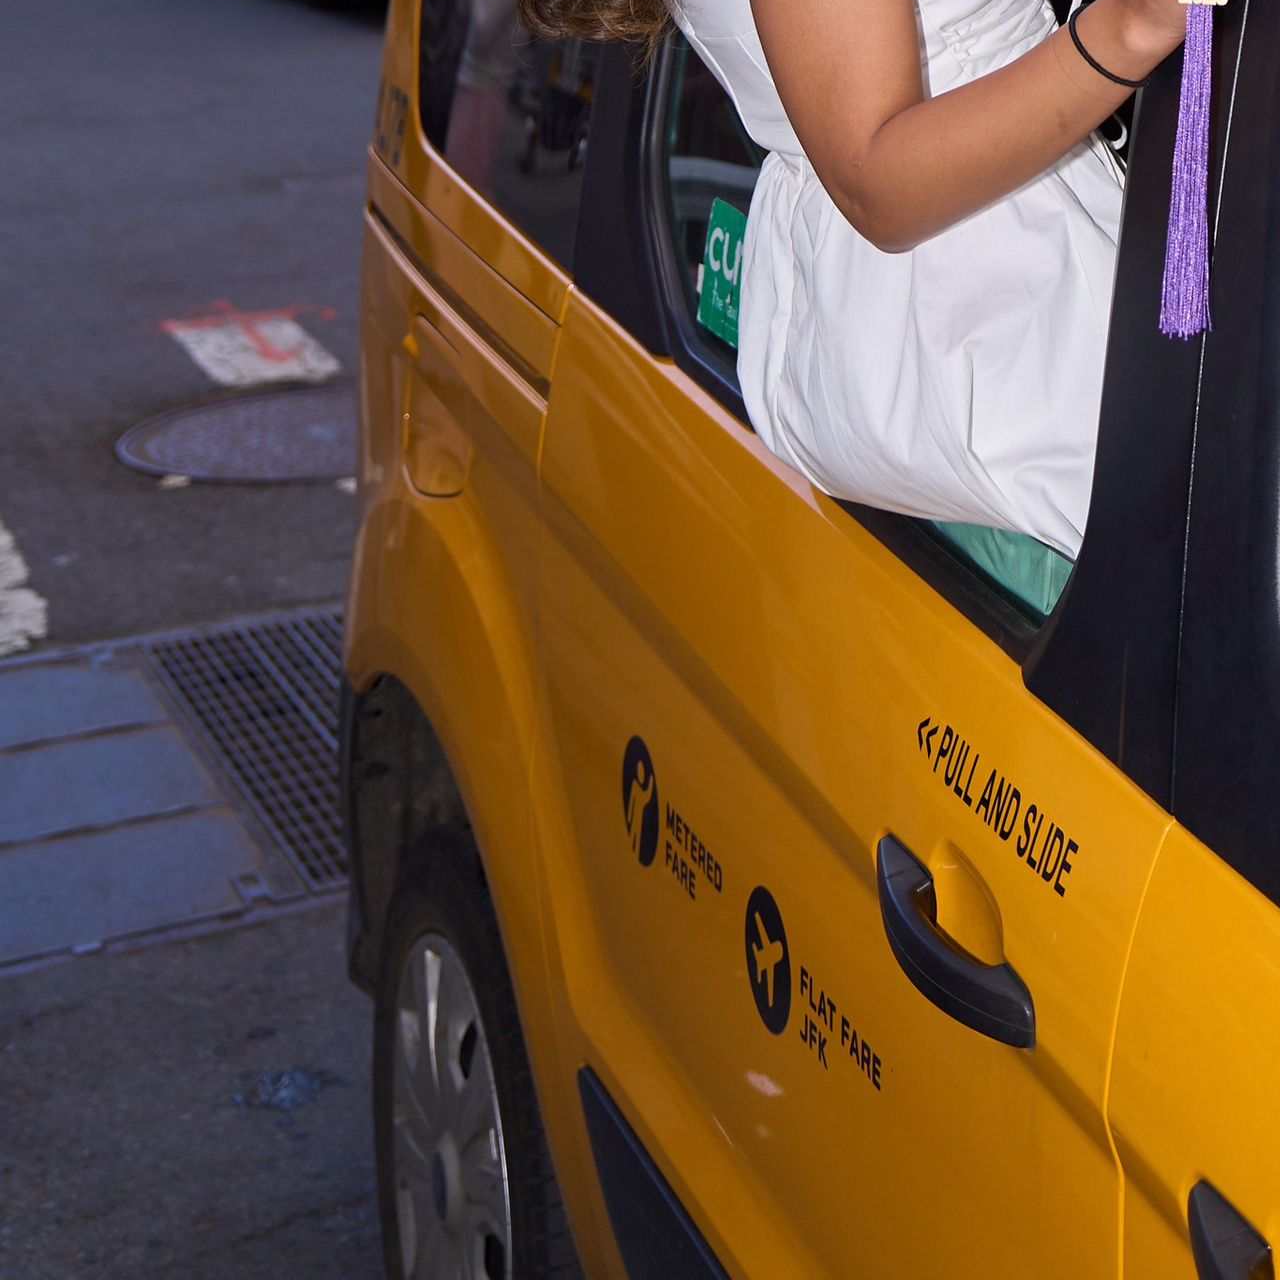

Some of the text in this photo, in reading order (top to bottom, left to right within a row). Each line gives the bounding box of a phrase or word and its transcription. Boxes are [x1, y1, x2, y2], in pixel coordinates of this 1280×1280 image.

[666, 801, 722, 893] METERED
[933, 724, 1079, 897] PULL AND SLIDE
[666, 843, 696, 901] FARE
[800, 1013, 828, 1070] JFK
[801, 965, 882, 1091] FLAT FARE
